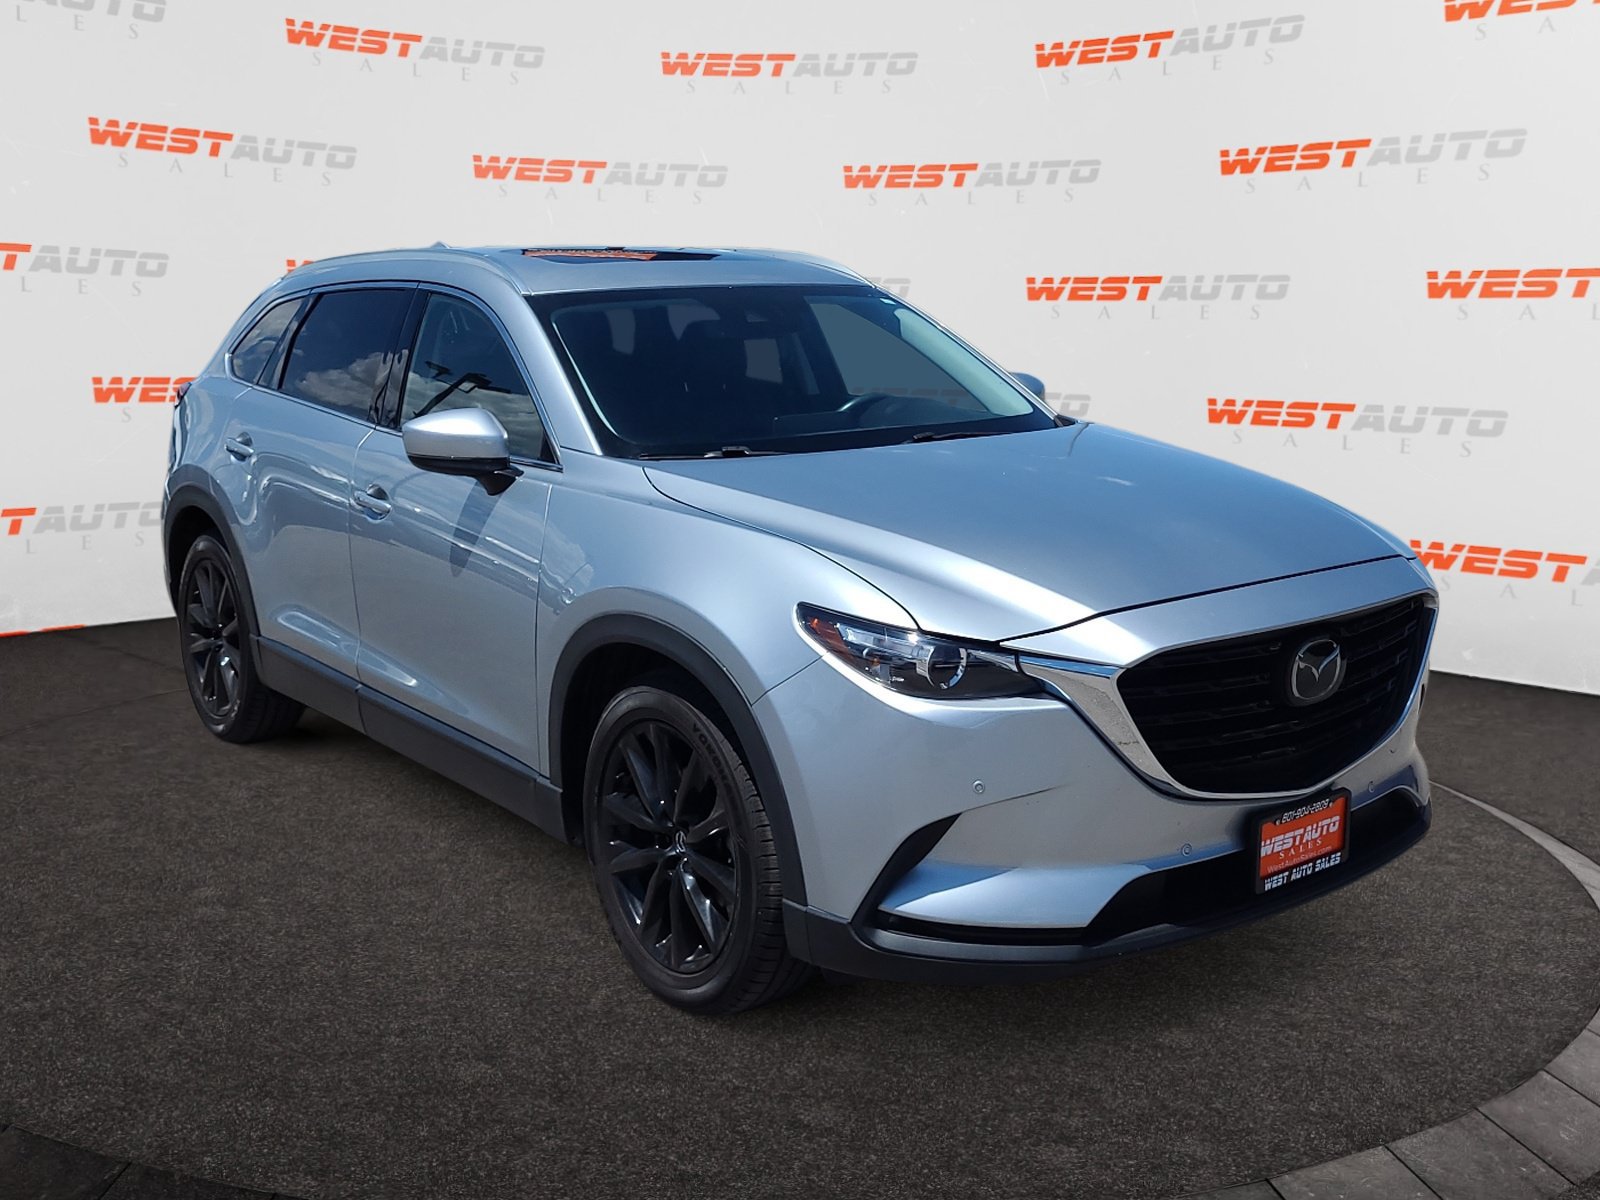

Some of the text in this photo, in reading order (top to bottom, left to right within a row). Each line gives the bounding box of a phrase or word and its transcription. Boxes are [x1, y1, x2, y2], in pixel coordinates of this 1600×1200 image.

[311, 51, 520, 86] SALES
[1060, 49, 1275, 86] SALES
[686, 79, 892, 95] SALES
[118, 151, 331, 187] SALES
[1245, 163, 1490, 194] SALES
[498, 183, 703, 206] SALES
[868, 187, 1074, 206] SALES
[1050, 304, 1260, 321] SALES
[1232, 428, 1473, 458] SALES
[1279, 838, 1322, 859] SALES
[1265, 852, 1341, 891] WEST AUTO SALES
